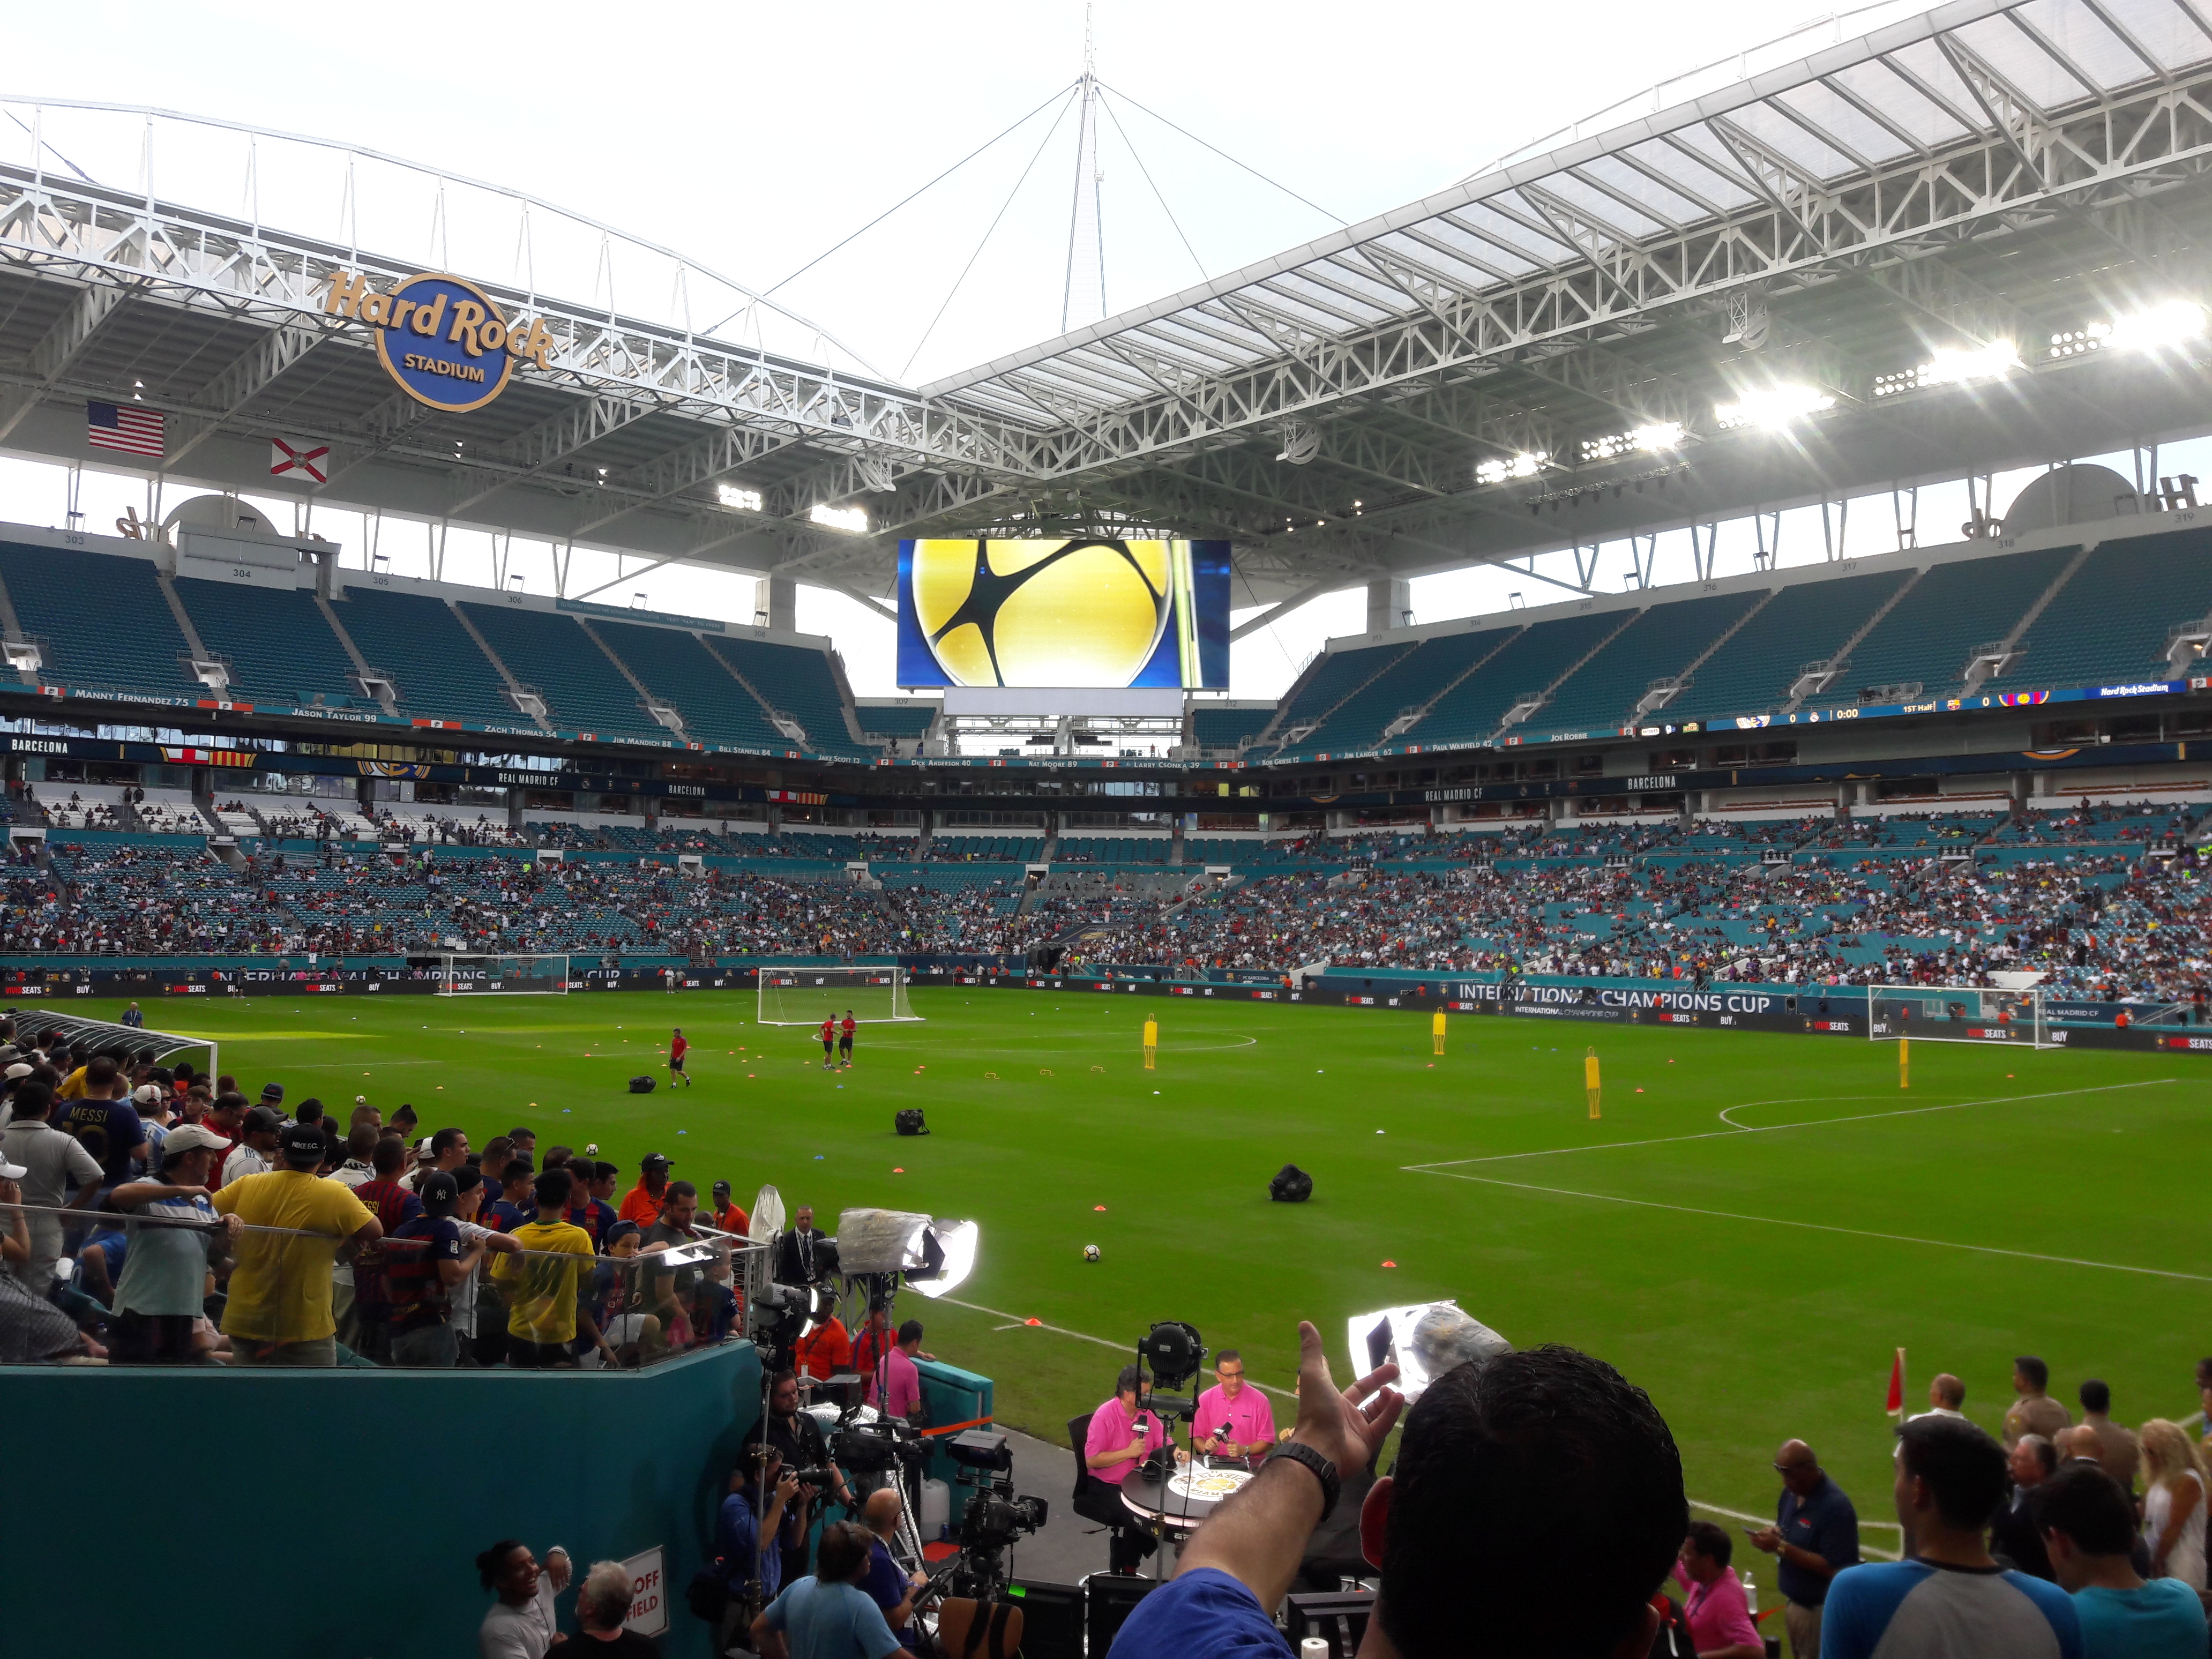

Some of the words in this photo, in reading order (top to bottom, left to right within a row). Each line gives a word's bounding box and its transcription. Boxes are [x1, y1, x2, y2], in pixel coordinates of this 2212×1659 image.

[324, 271, 448, 337] Hard
[447, 298, 554, 371] Rock
[404, 353, 485, 383] STADIUM
[2174, 512, 2194, 523] 319
[65, 535, 84, 545] 303
[1997, 538, 2014, 549] 318
[1842, 562, 1857, 571] 317
[233, 568, 252, 579] 304
[372, 577, 389, 586] 305
[507, 595, 522, 604] 306
[1580, 602, 1592, 610] 315
[754, 630, 766, 638] 308
[2101, 686, 2119, 696] Hard
[2120, 685, 2138, 695] Rock
[2137, 684, 2169, 693] Stadium
[75, 689, 115, 700] MANNY
[117, 692, 172, 706] FERNANDEZ
[175, 697, 189, 707] 75
[1982, 697, 1990, 707] 0
[1903, 705, 1916, 713] 1ST
[1917, 703, 1933, 712] Half
[291, 708, 323, 719] JASON
[325, 709, 362, 722] TAYLOR
[364, 714, 377, 723] 99
[1789, 714, 1797, 723] 0
[1837, 708, 1859, 720] 0:00
[484, 724, 507, 735] ZACH
[511, 727, 544, 738] THOMAS
[545, 730, 557, 738] 54
[611, 736, 625, 744] JIM
[627, 737, 660, 747] MANDICH
[662, 740, 672, 748] 88
[1550, 734, 1563, 742] JOE
[1563, 732, 1588, 741] ROBBIE
[11, 739, 69, 754] BARCELONA
[719, 745, 731, 753] BILL
[733, 747, 760, 756] STANFILL
[1432, 744, 1448, 752] PAUL
[1449, 742, 1481, 750] WARFIELD
[1482, 739, 1493, 748] 42
[817, 754, 832, 762] JAKE
[834, 755, 852, 763] SCOTT
[1355, 750, 1379, 758] LANGER
[1067, 760, 1078, 768] 89
[498, 772, 516, 783] REAL
[518, 774, 547, 785] MADRID
[549, 776, 559, 787] CF
[1627, 775, 1676, 790] BARCELONA
[668, 784, 706, 797] BARCELONA
[1425, 790, 1441, 802] REAL
[1443, 788, 1471, 801] MADRID
[1474, 787, 1483, 798] CF
[76, 985, 91, 994] BUY
[369, 983, 380, 991] BUY
[491, 982, 502, 990] BUY
[1727, 995, 1771, 1014] CUP
[1515, 1006, 1564, 1015] INTERNATIONAL
[1720, 1015, 1733, 1025] BUY
[1873, 1022, 1888, 1033] BUY
[2051, 1031, 2068, 1042] BUY
[69, 1105, 109, 1123] MESSI
[634, 1569, 659, 1595] OFF
